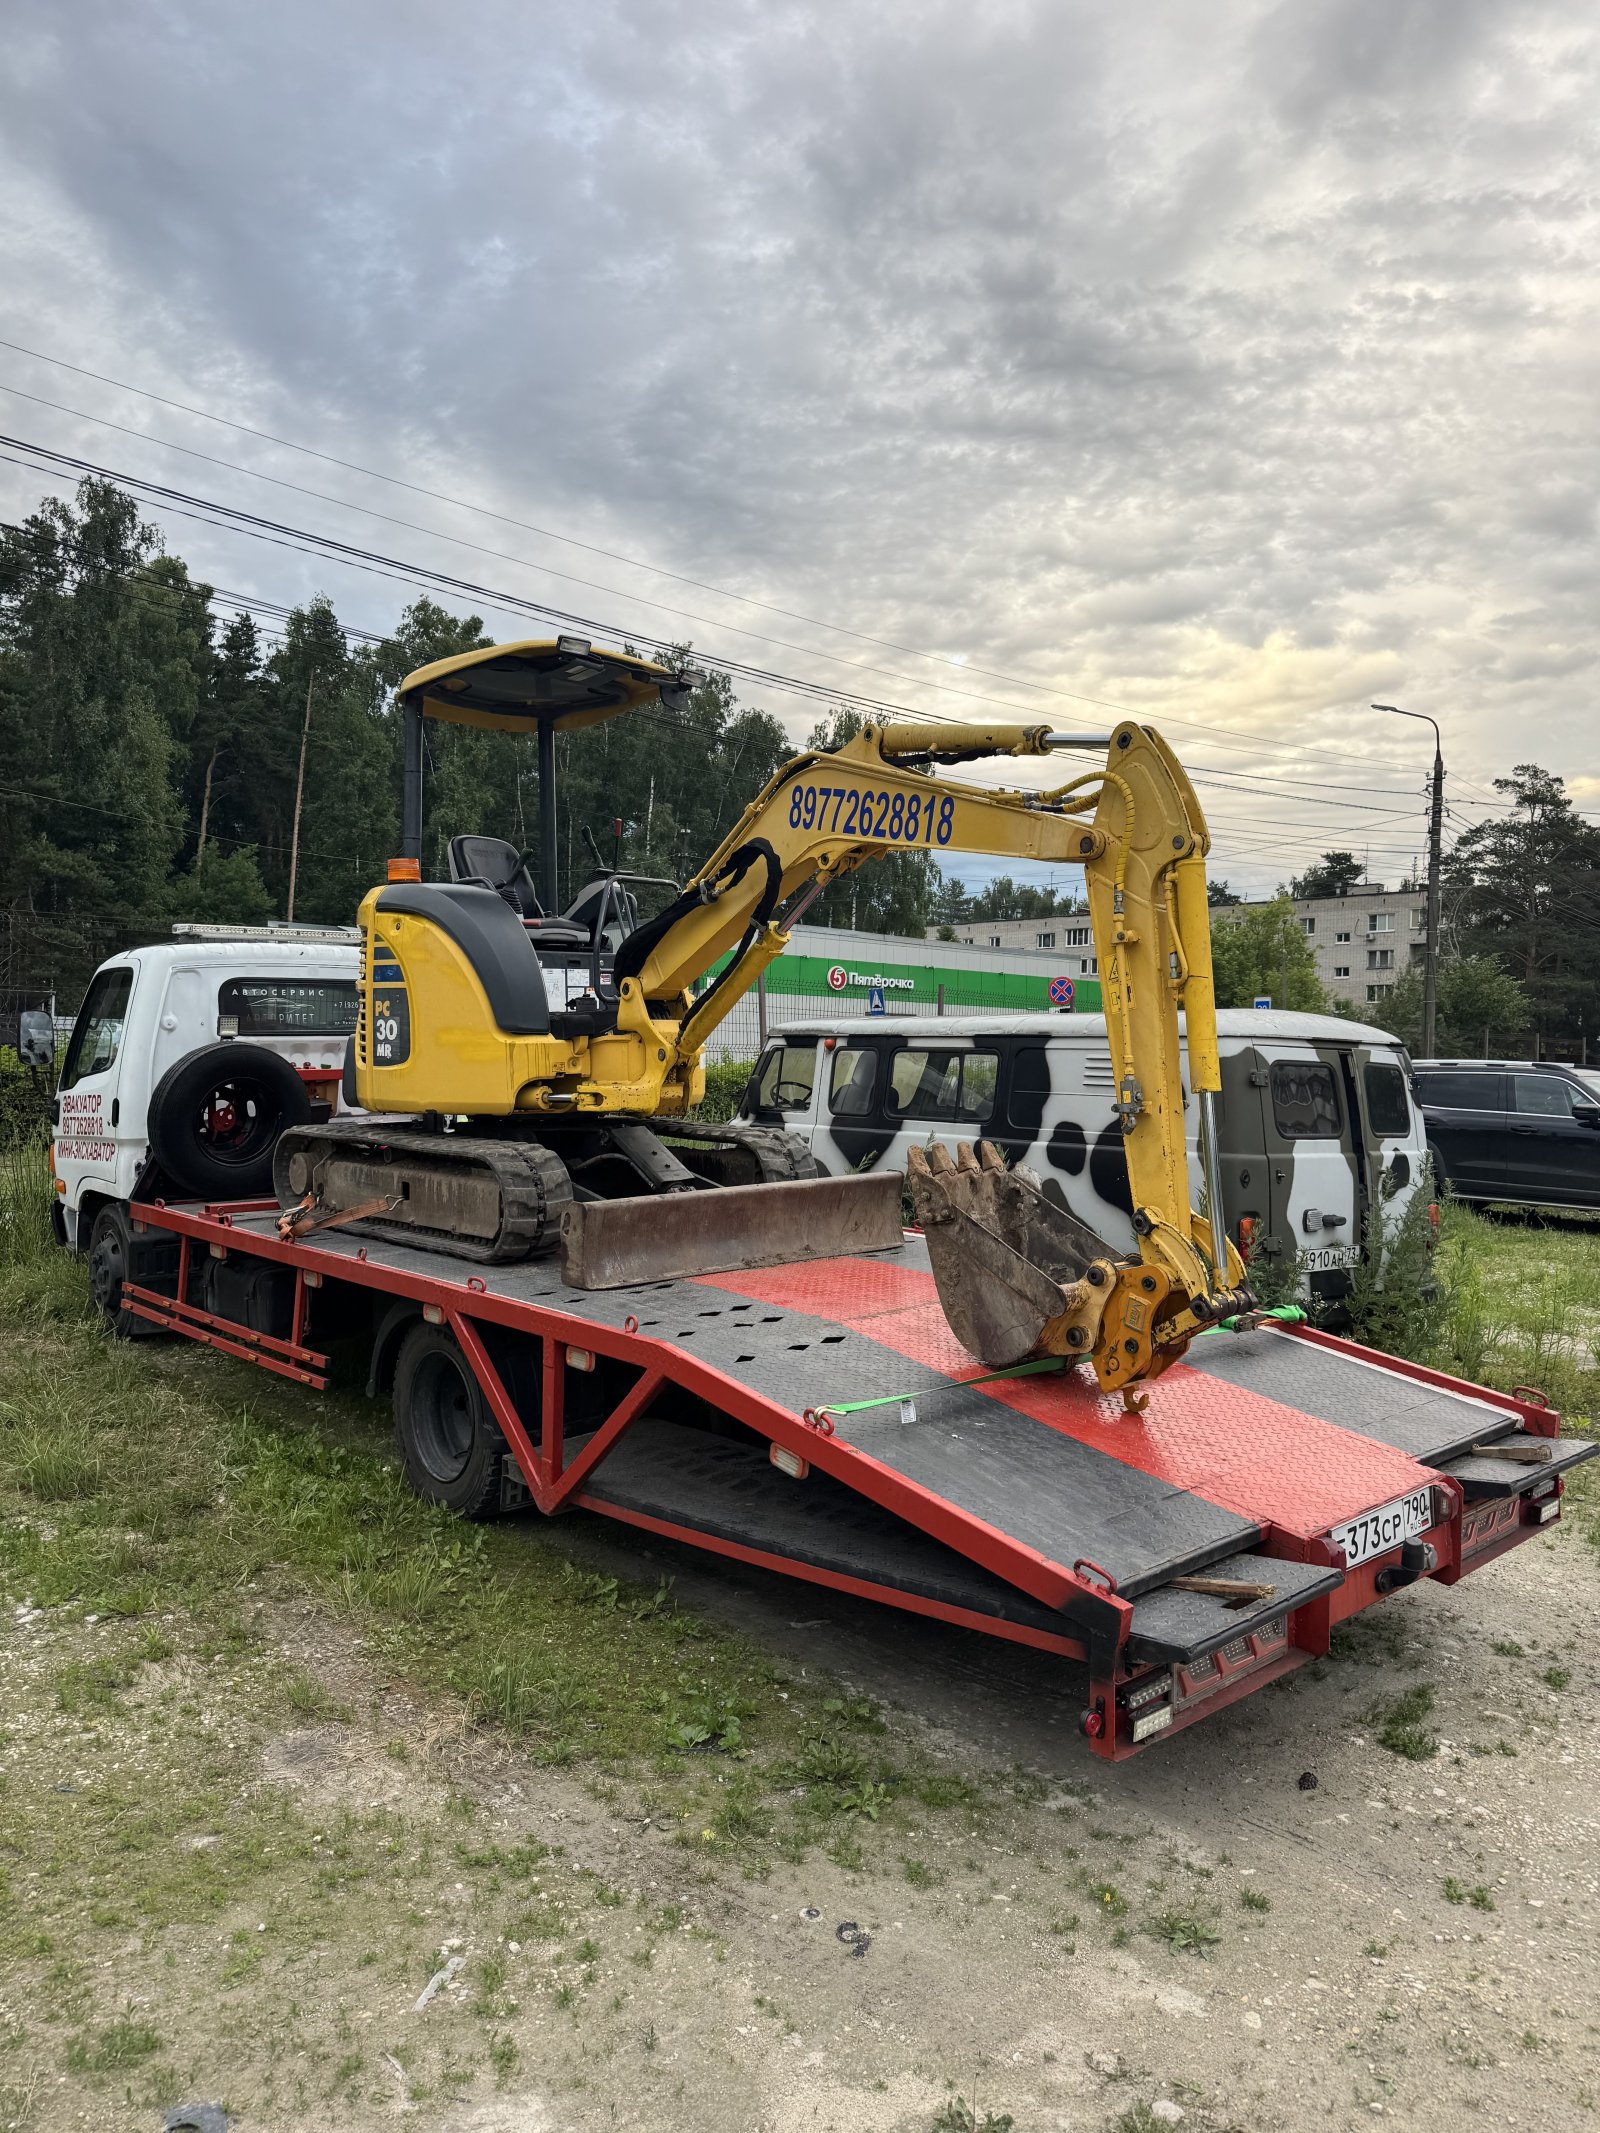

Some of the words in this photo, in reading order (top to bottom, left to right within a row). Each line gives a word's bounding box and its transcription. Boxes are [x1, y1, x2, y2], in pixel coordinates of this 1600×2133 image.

[789, 785, 955, 846] 89772628818
[848, 972, 915, 989] Пятёрочка
[231, 988, 325, 996] АВТОСЕРВИС
[375, 1000, 390, 1017] PC
[376, 1019, 398, 1041] 30
[376, 1043, 392, 1057] MR
[62, 1094, 102, 1113] ЭВАКУАТОР
[62, 1116, 104, 1136] 89772628818
[1303, 1250, 1344, 1269] 910АН
[1346, 1247, 1356, 1260] 73
[1336, 1513, 1402, 1560] 373СР
[1403, 1492, 1426, 1525] 790
[1410, 1519, 1422, 1533] RUS
